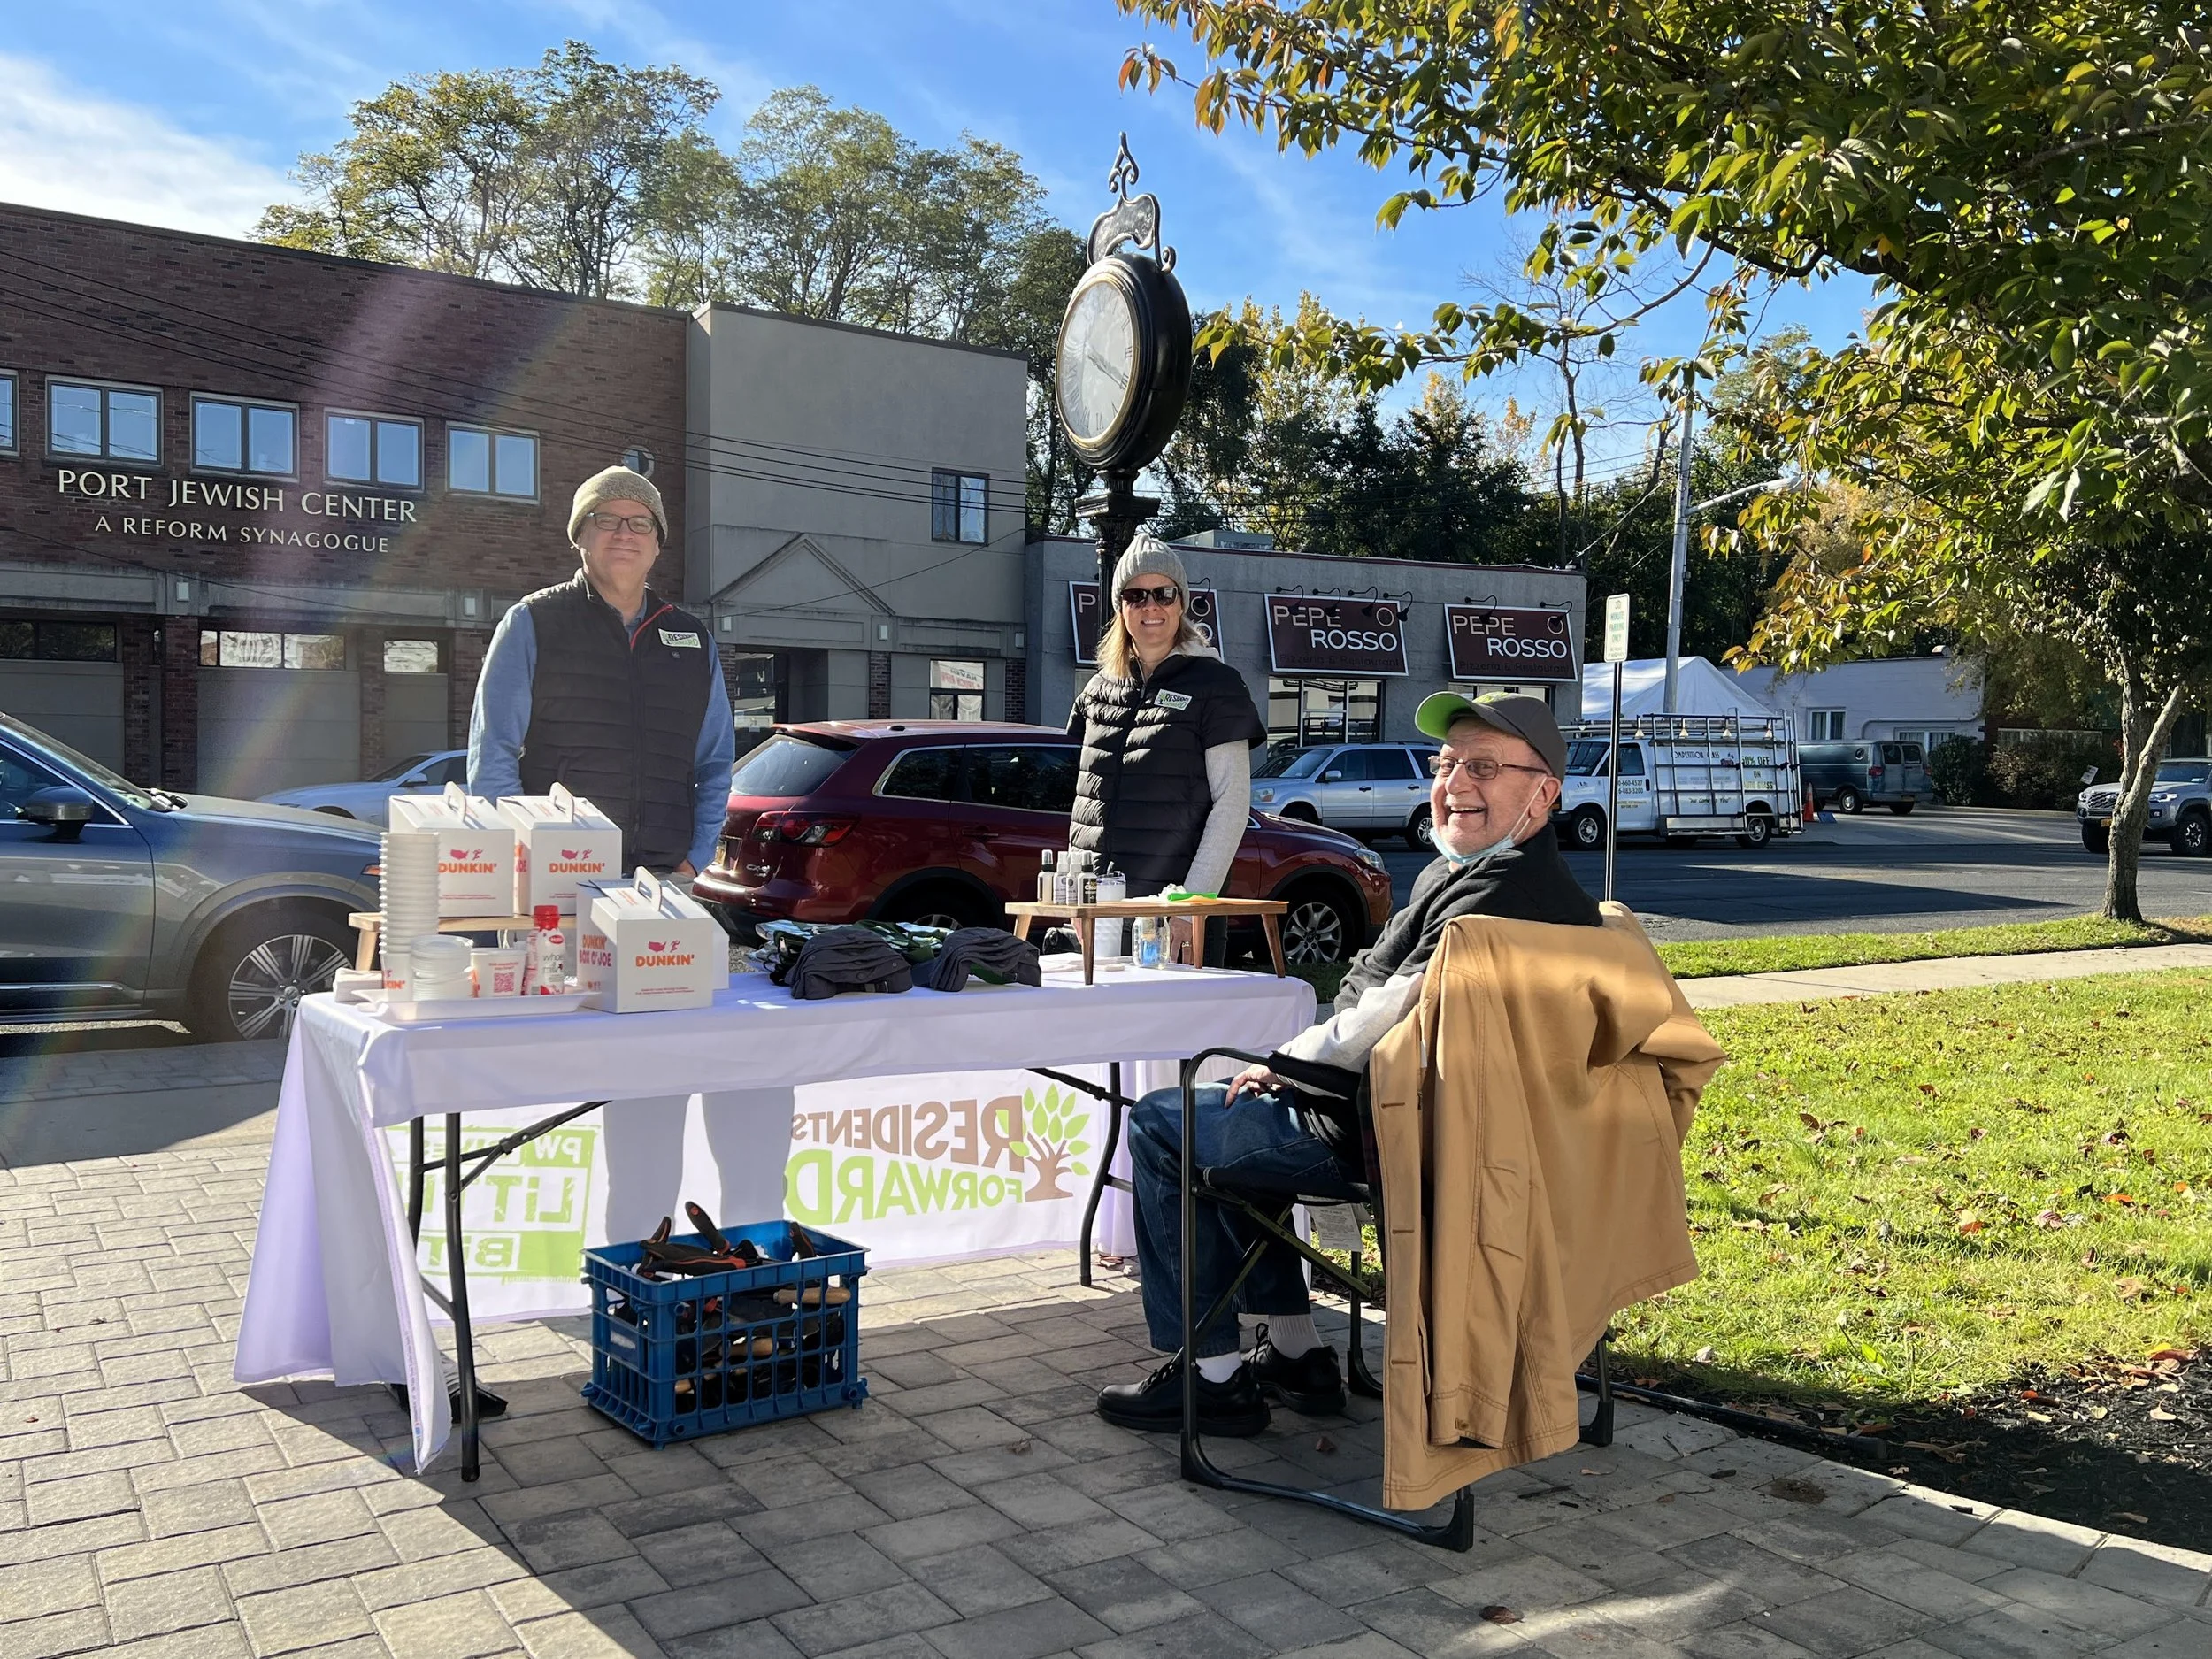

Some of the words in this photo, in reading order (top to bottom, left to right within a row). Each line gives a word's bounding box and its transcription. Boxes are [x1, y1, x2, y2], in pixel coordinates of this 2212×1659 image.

[58, 469, 153, 500] PORT
[168, 479, 284, 511] JEWISH
[301, 492, 417, 523] CENTER
[95, 516, 111, 532] A
[123, 517, 227, 541] REFORM
[240, 526, 389, 553] SYNAGOGUE
[1272, 605, 1342, 627] PEPE
[1452, 615, 1516, 636] PEPE
[1310, 629, 1398, 651] ROSSO
[1486, 637, 1568, 658] ROSSO
[1279, 653, 1324, 664] Pizzeria
[1340, 655, 1399, 666] Restaurant
[1458, 661, 1502, 671] Pizzeria
[1514, 662, 1570, 672] Restaurant
[1757, 756, 1770, 766] OFF
[438, 863, 497, 873] DUNKIN'
[549, 863, 605, 873] DUNKIN'
[582, 934, 608, 950] DUNKIN'
[579, 949, 590, 964] BOX
[597, 952, 612, 967] JOE
[635, 954, 695, 967] DUNKIN'
